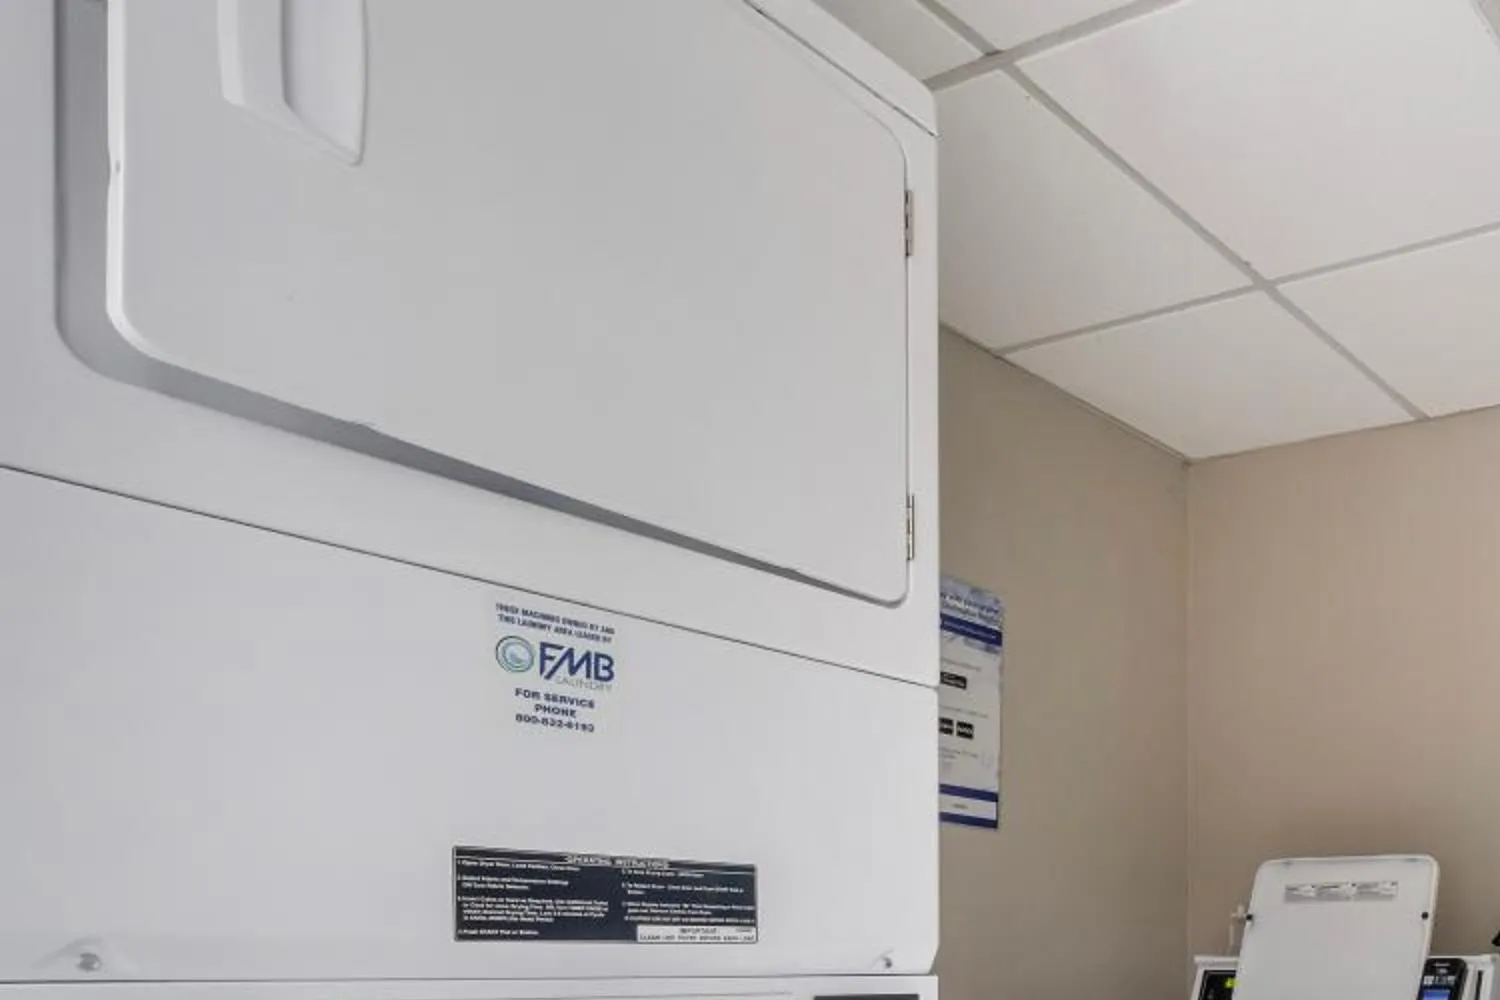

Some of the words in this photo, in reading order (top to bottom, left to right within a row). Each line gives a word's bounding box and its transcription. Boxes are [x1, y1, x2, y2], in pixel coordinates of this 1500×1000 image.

[539, 641, 615, 682] FMB
[514, 687, 541, 700] FOR
[544, 691, 595, 709] SERVICE
[534, 703, 577, 719] PHONE
